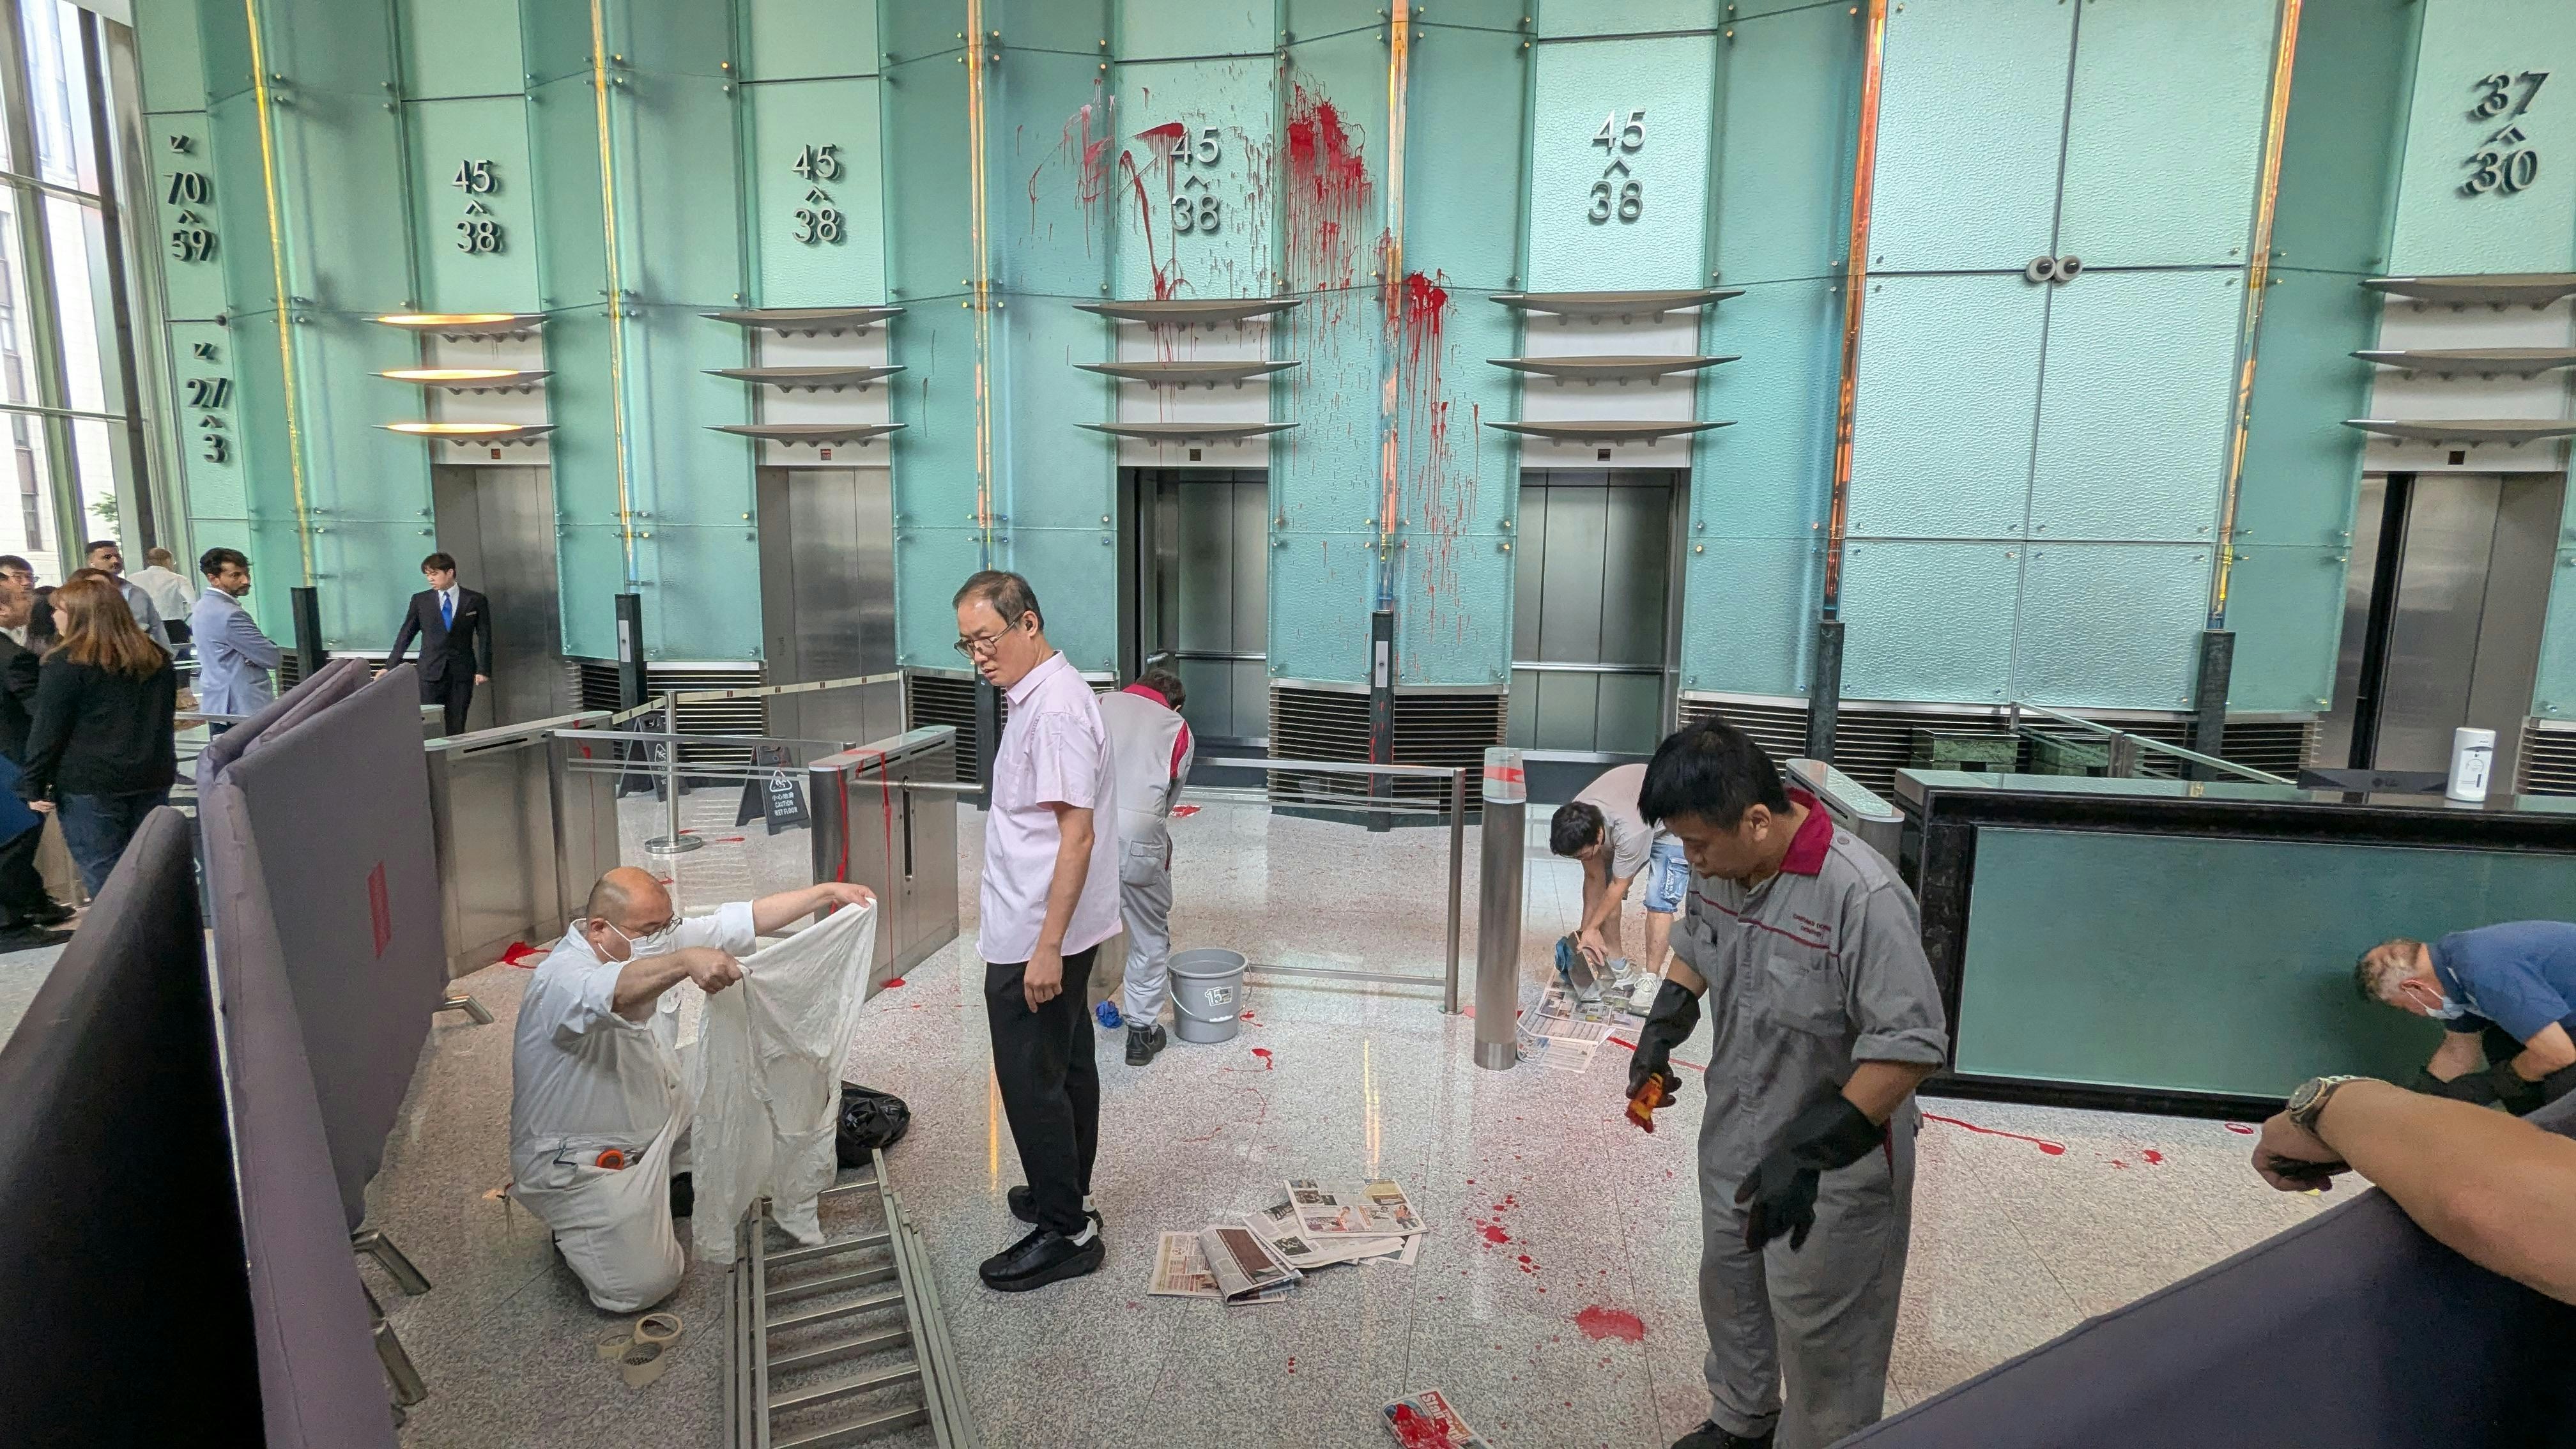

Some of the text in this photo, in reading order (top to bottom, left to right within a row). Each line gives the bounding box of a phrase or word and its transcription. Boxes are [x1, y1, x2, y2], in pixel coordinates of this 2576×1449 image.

[2474, 70, 2550, 119] 37
[1170, 125, 1220, 165] 45
[1592, 107, 1647, 155] 45
[451, 158, 497, 194] 45
[791, 142, 841, 181] 45
[2464, 148, 2539, 194] 30
[162, 171, 208, 205] 70
[1588, 180, 1644, 222] 38
[792, 207, 841, 244] 38
[1171, 194, 1221, 233] 38
[171, 228, 214, 262] 59
[456, 219, 500, 254] 38
[187, 376, 229, 408] 27
[203, 433, 226, 463] 3
[774, 806, 798, 816] WET FLOOR
[775, 799, 793, 808] CAUTION
[1206, 988, 1222, 1005] 15
